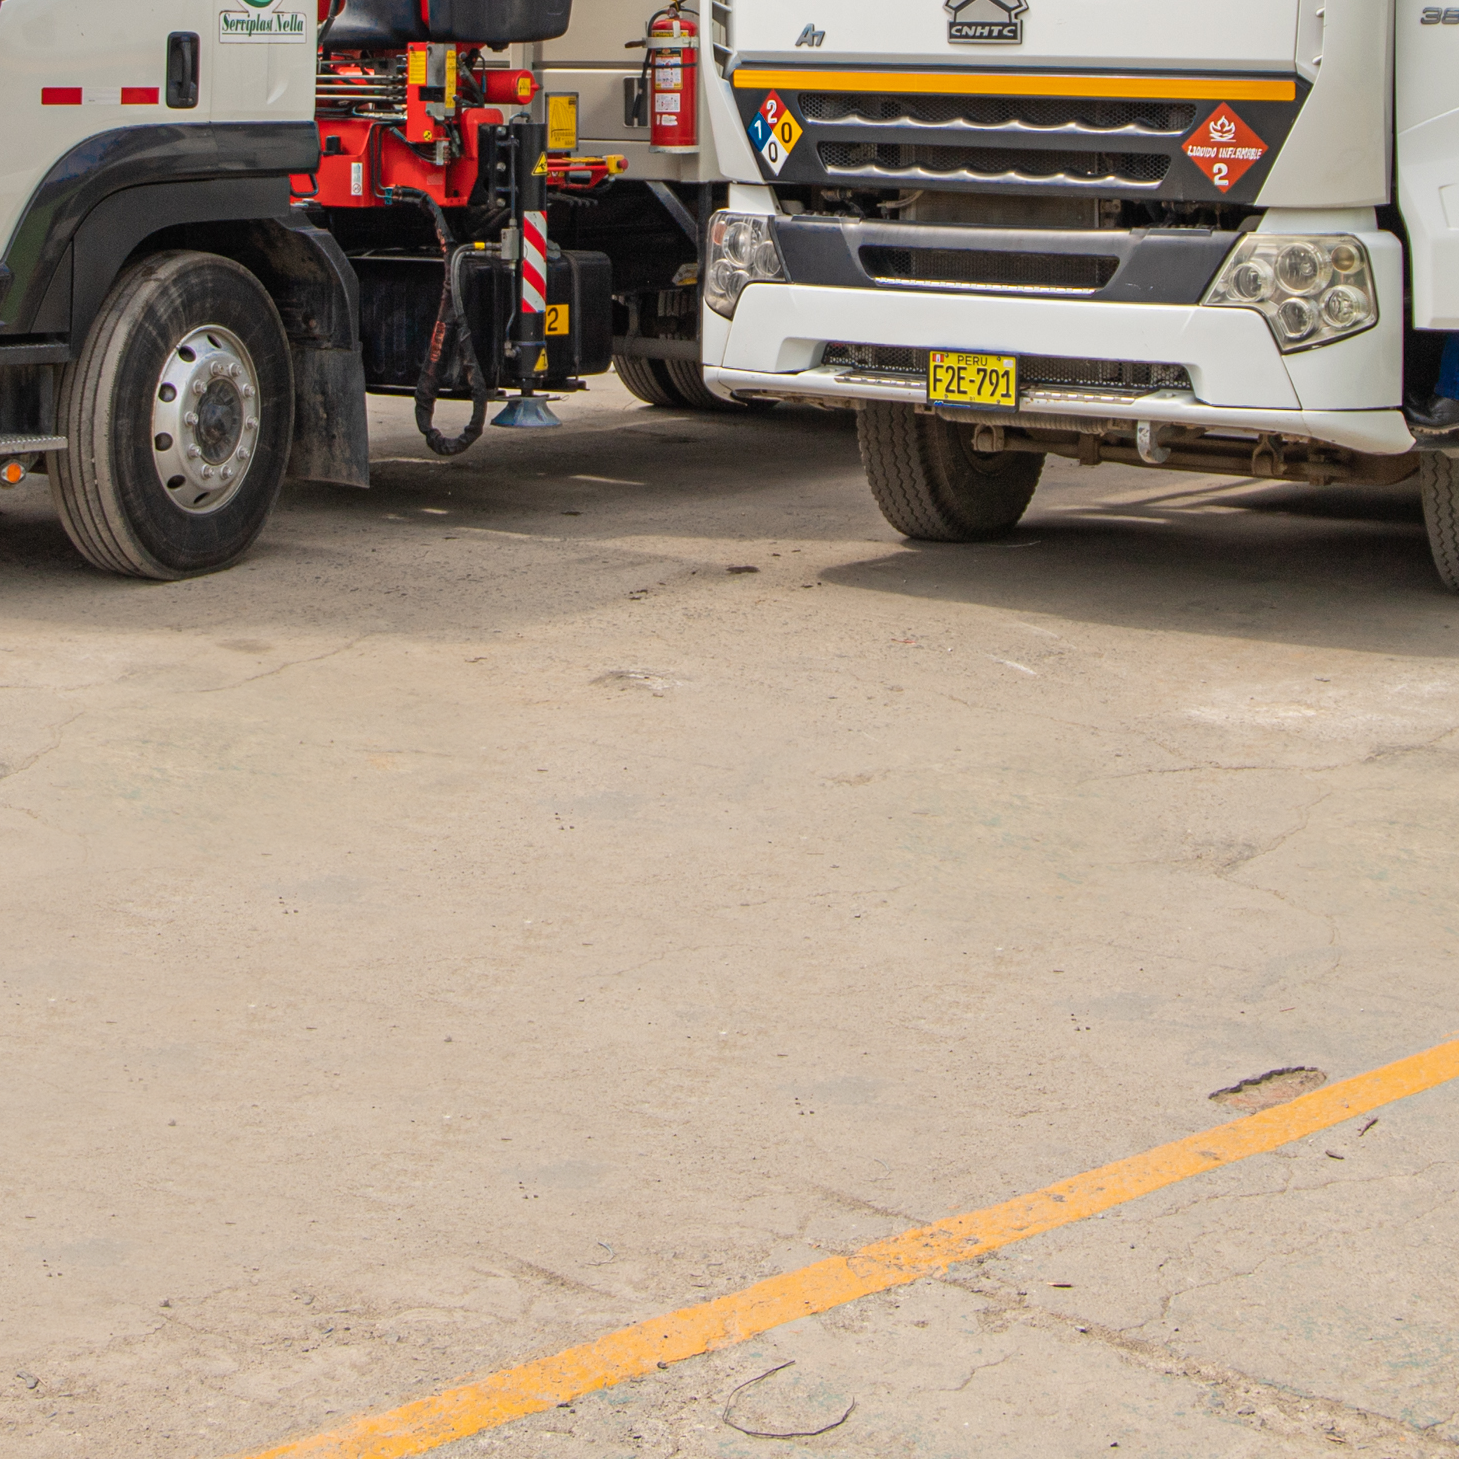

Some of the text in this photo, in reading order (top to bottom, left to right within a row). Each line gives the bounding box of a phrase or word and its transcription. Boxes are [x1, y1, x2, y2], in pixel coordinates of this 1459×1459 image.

[222, 13, 304, 37] Serviplast Nella
[795, 23, 826, 46] A7
[950, 25, 1016, 37] CNHTC
[766, 99, 778, 124] 2
[754, 119, 793, 144] 1 0
[768, 141, 778, 164] 0
[1187, 144, 1263, 160] LIQUIDO INFLAMABLE
[1212, 162, 1229, 186] 2
[957, 355, 988, 366] PERU
[933, 364, 1012, 398] F2E-791
